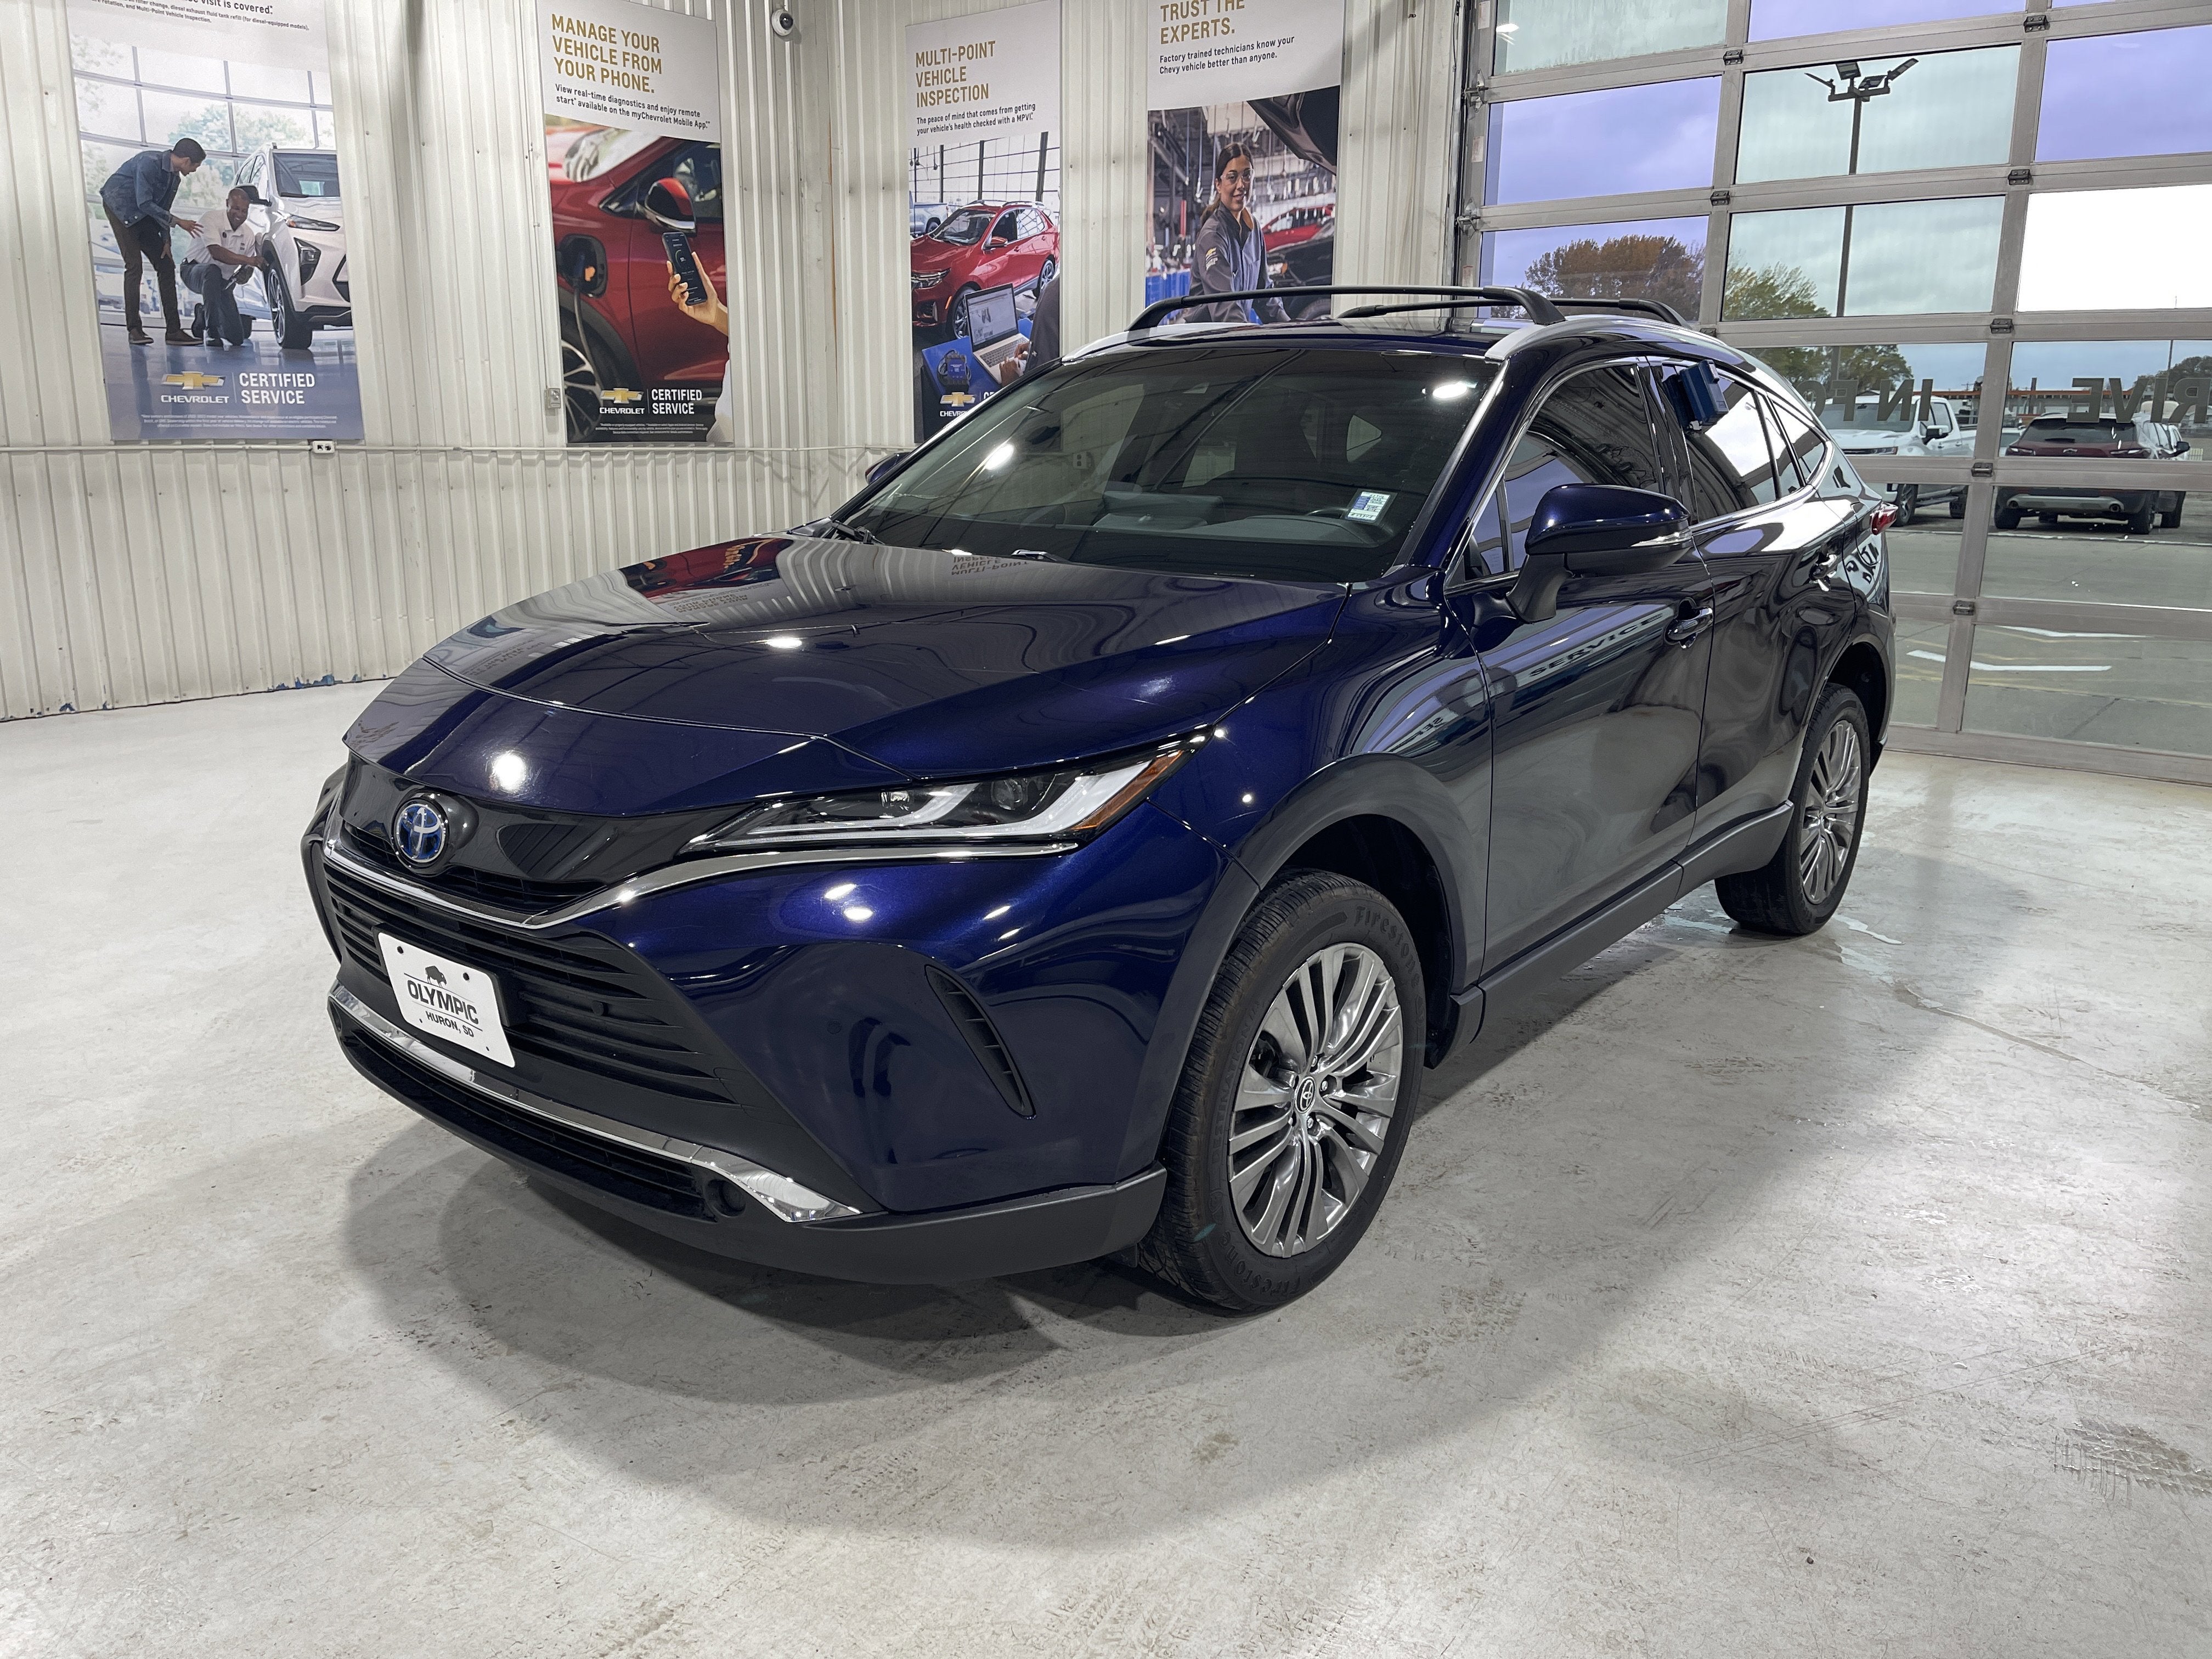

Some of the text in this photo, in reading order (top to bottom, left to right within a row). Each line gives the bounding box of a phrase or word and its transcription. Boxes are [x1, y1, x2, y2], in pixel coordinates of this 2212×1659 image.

[137, 5, 165, 15] Multi-Point
[185, 14, 212, 22] Inspection.
[1160, 0, 1209, 22] TRUST
[551, 14, 660, 53] MANAGE YOUR
[1160, 17, 1235, 44] EXPERTS.
[552, 35, 662, 75] VEHICLE FROM
[916, 41, 996, 67] MULTI-POINT
[1160, 36, 1295, 63] Factory trained technicians know your
[554, 57, 655, 93] YOUR PHONE.
[1160, 52, 1278, 75] Chevy vehicle better than anyone.
[916, 66, 967, 88] VEHICLE
[555, 83, 701, 117] View real-time diagnostics and enjoy remote
[917, 83, 989, 108] INSPECTION
[578, 100, 607, 112] available
[619, 107, 630, 116] the
[631, 111, 672, 124] myChevrolet
[673, 116, 693, 127] Mobile
[928, 116, 944, 125] peace
[945, 113, 950, 121] of
[952, 111, 965, 120] mind
[967, 110, 978, 119] that
[1014, 103, 1036, 114] getting
[917, 127, 929, 136] your
[930, 123, 953, 133] vehicle's
[954, 121, 972, 130] health
[973, 118, 996, 128] checked
[997, 116, 1010, 125] with
[239, 373, 315, 388] CERTIFIED
[161, 395, 229, 404] CHEVROLET
[241, 390, 305, 404] SERVICE
[651, 389, 702, 401] CERTIFIED
[652, 403, 695, 414] SERVICE
[407, 980, 479, 1025] OLYMPIC
[425, 1011, 475, 1037] HURON, SD
